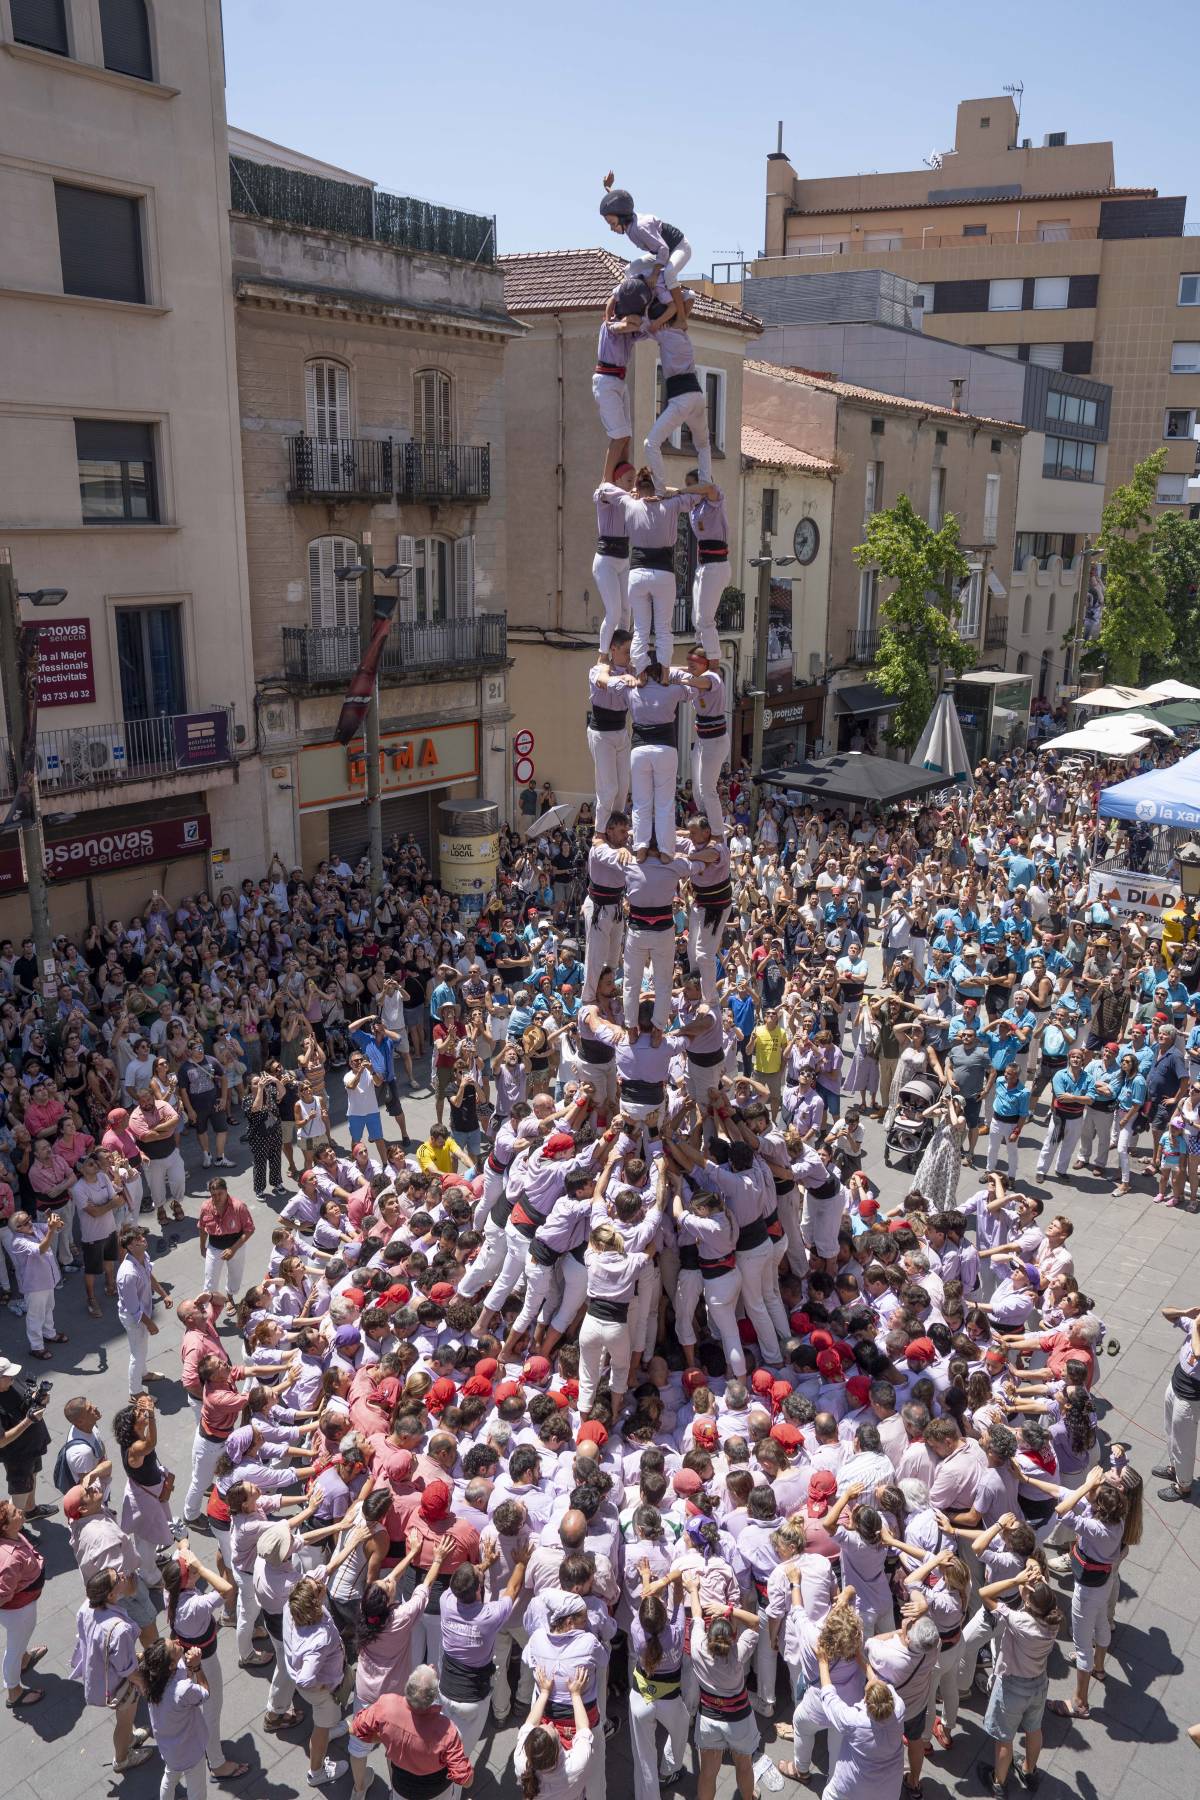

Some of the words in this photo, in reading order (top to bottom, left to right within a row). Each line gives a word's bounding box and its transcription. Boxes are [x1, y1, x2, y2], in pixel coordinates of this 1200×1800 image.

[50, 651, 59, 661] al
[60, 650, 87, 660] Major
[38, 672, 88, 684] l·lectivitats
[42, 693, 52, 702] 93
[54, 692, 68, 700] 733
[80, 690, 90, 698] 32
[489, 682, 502, 699] 21
[1159, 805, 1173, 820] la
[1176, 808, 1200, 824] xar
[44, 829, 154, 866] asanovas
[452, 843, 473, 851] LOVE
